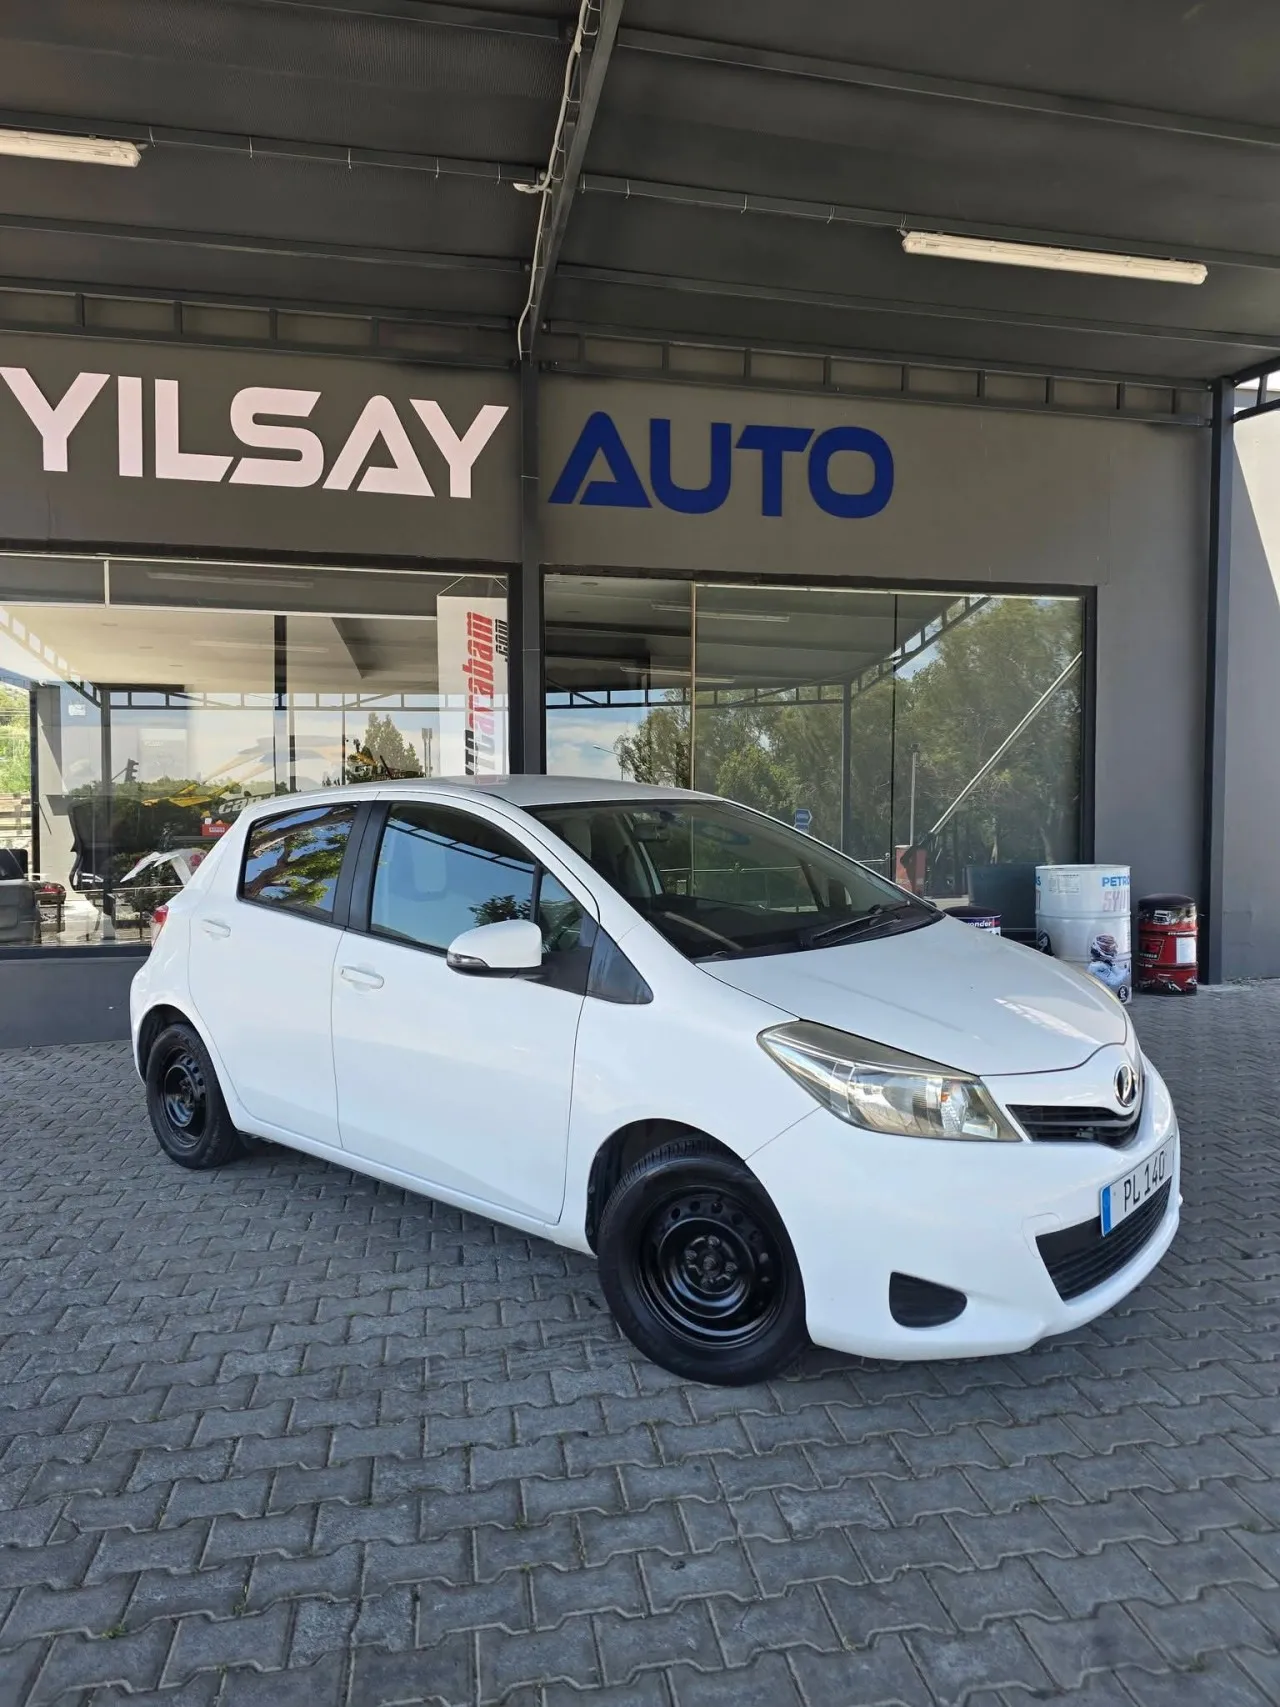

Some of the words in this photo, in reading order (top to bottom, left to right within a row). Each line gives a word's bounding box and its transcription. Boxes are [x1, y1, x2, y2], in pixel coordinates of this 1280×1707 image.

[0, 366, 510, 499] YILSAY
[548, 411, 894, 519] AUTO
[1123, 1174, 1140, 1212] PL
[1144, 1150, 1165, 1196] 140
